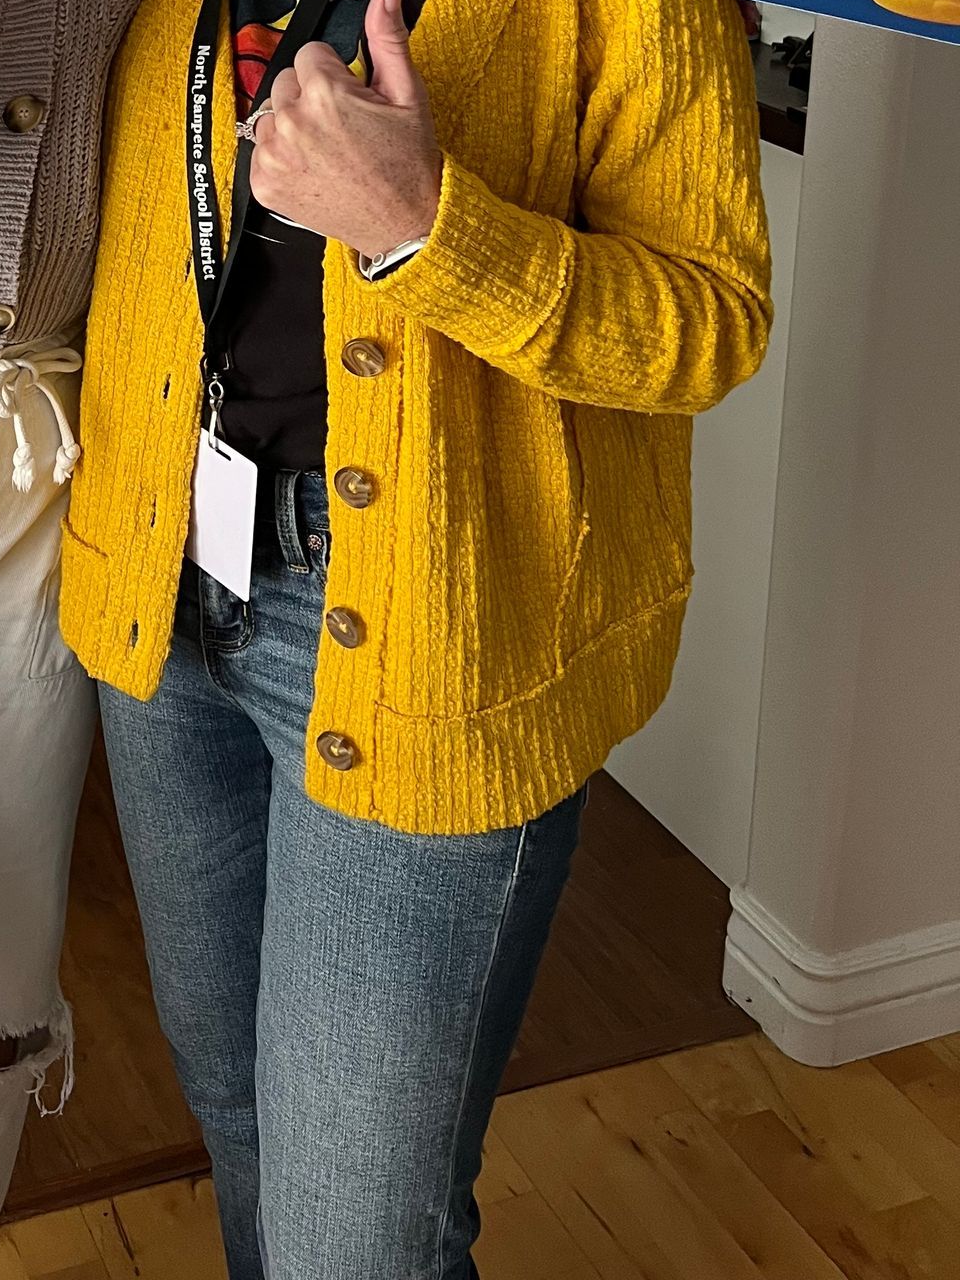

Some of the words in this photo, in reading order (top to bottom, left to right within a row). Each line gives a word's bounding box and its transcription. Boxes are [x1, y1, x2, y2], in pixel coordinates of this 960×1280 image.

[191, 45, 211, 94] North
[190, 94, 207, 160] Sanpete
[193, 163, 213, 218] School
[198, 221, 216, 281] District
